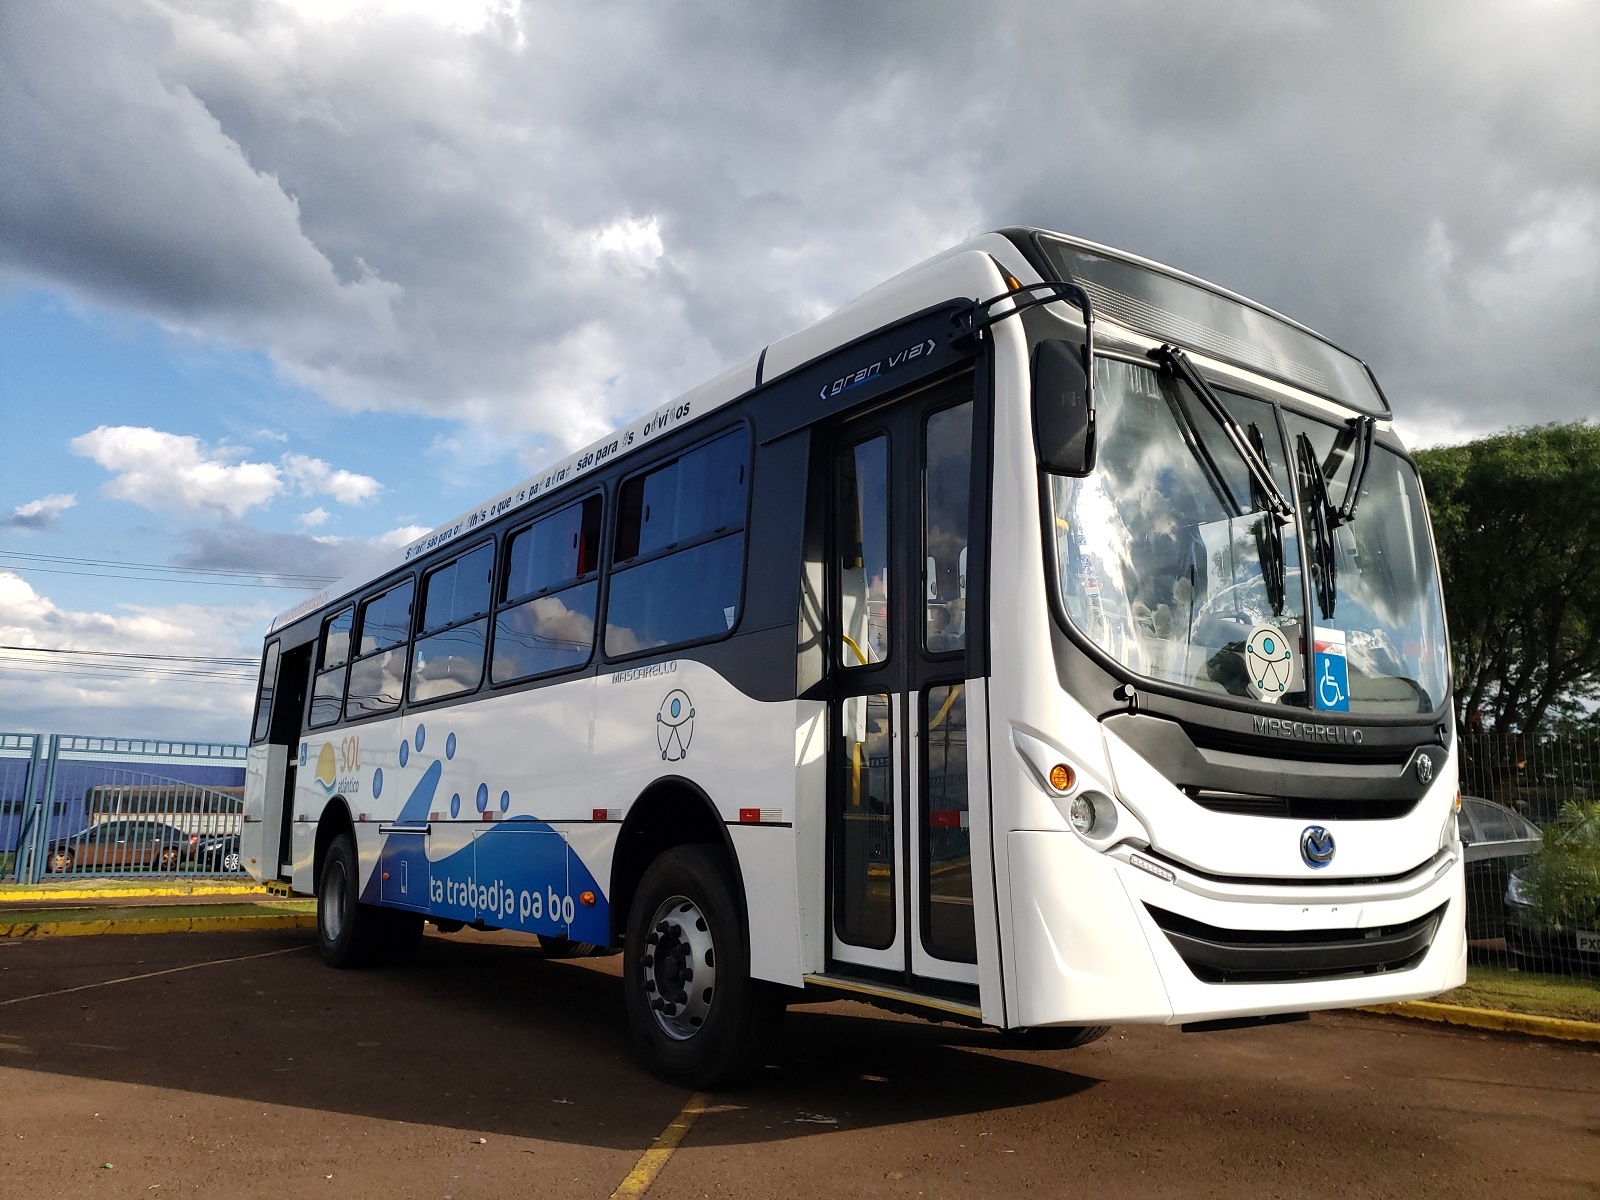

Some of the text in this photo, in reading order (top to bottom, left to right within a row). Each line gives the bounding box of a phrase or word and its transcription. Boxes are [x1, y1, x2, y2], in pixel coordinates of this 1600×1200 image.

[438, 528, 453, 546] para
[497, 496, 512, 515] que
[576, 452, 593, 471] são
[595, 440, 619, 466] para
[612, 660, 677, 684] MASCARELLO
[1253, 715, 1363, 745] MASCARELLO
[340, 735, 361, 773] SOL
[430, 875, 575, 924] ta trabadja pa bo
